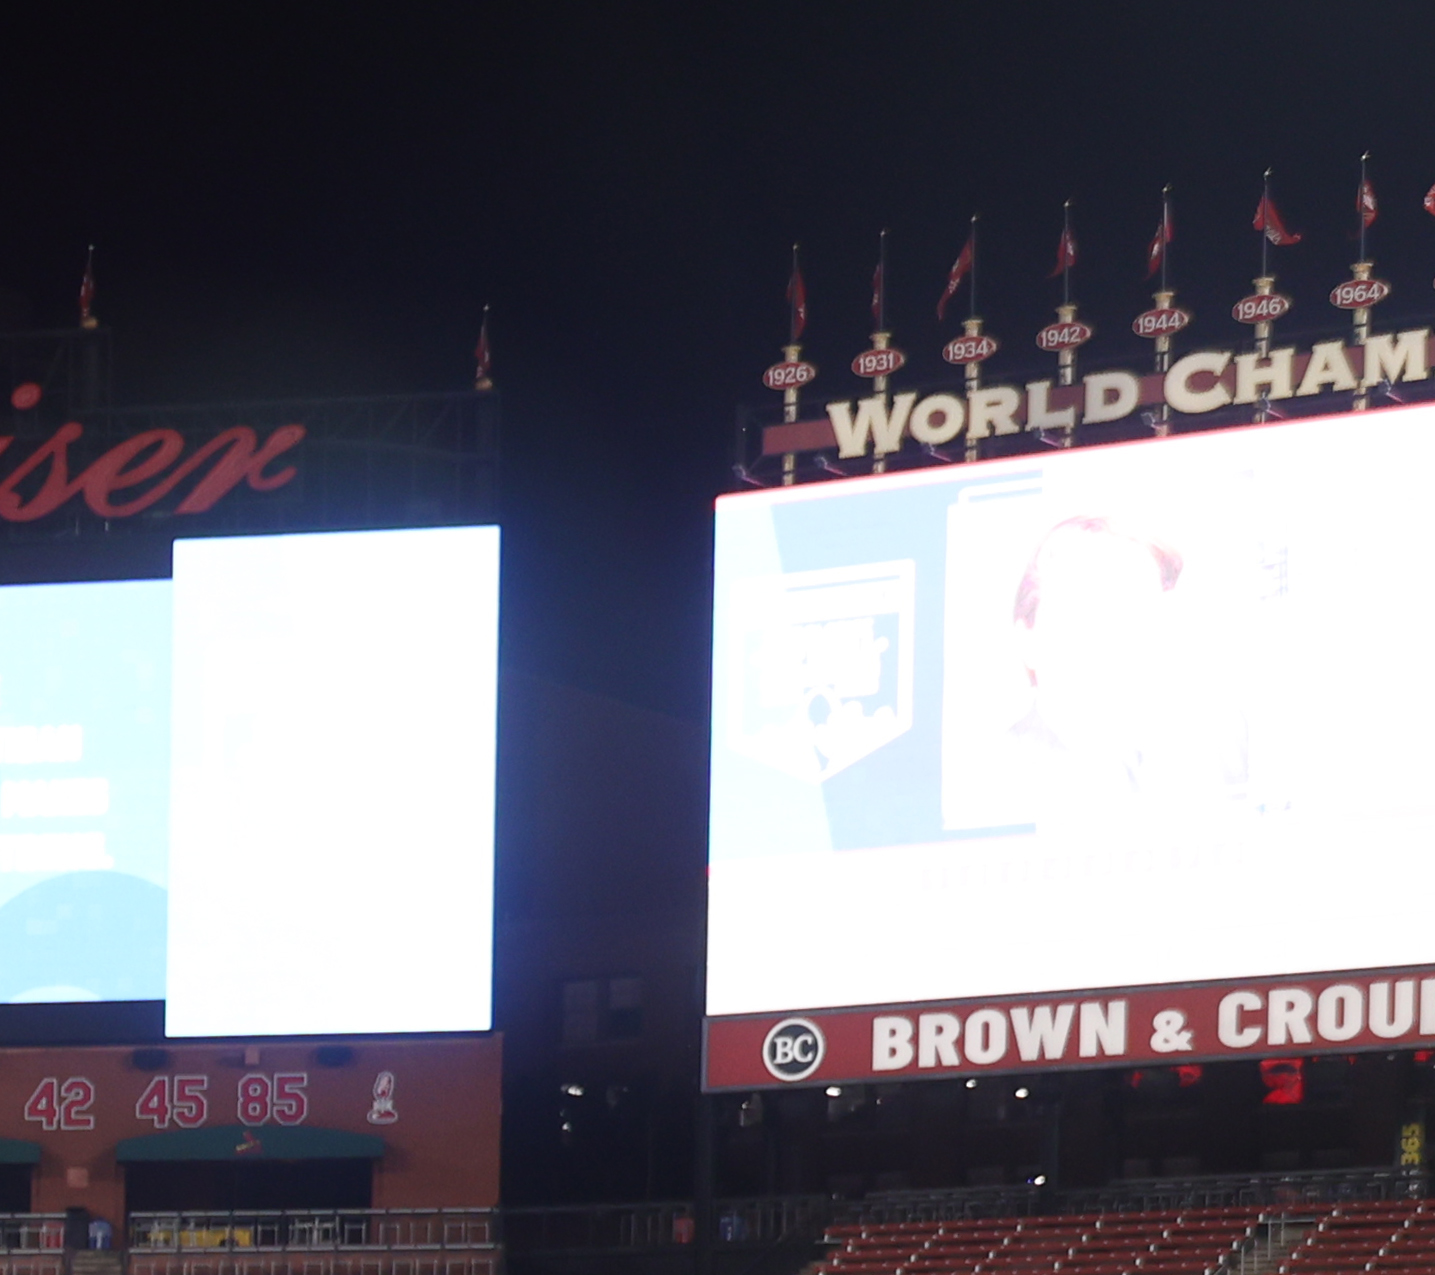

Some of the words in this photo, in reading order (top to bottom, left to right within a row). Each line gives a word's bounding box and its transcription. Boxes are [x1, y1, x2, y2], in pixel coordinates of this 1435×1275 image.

[1335, 281, 1381, 304] 1964
[1237, 296, 1281, 318] 1946
[1137, 312, 1179, 332] 1944
[1040, 325, 1082, 348] 1942
[947, 338, 988, 362] 1934
[767, 363, 808, 387] 1926
[858, 352, 894, 374] 1931
[826, 370, 1139, 460] WORLD
[1164, 327, 1430, 415] CHAM
[772, 1031, 817, 1069] BC
[872, 999, 1128, 1072] BROWN
[1149, 1009, 1193, 1053] &
[1218, 977, 1435, 1047] CROU
[24, 1077, 96, 1131] 42
[135, 1075, 209, 1128] 45
[237, 1073, 308, 1126] 85
